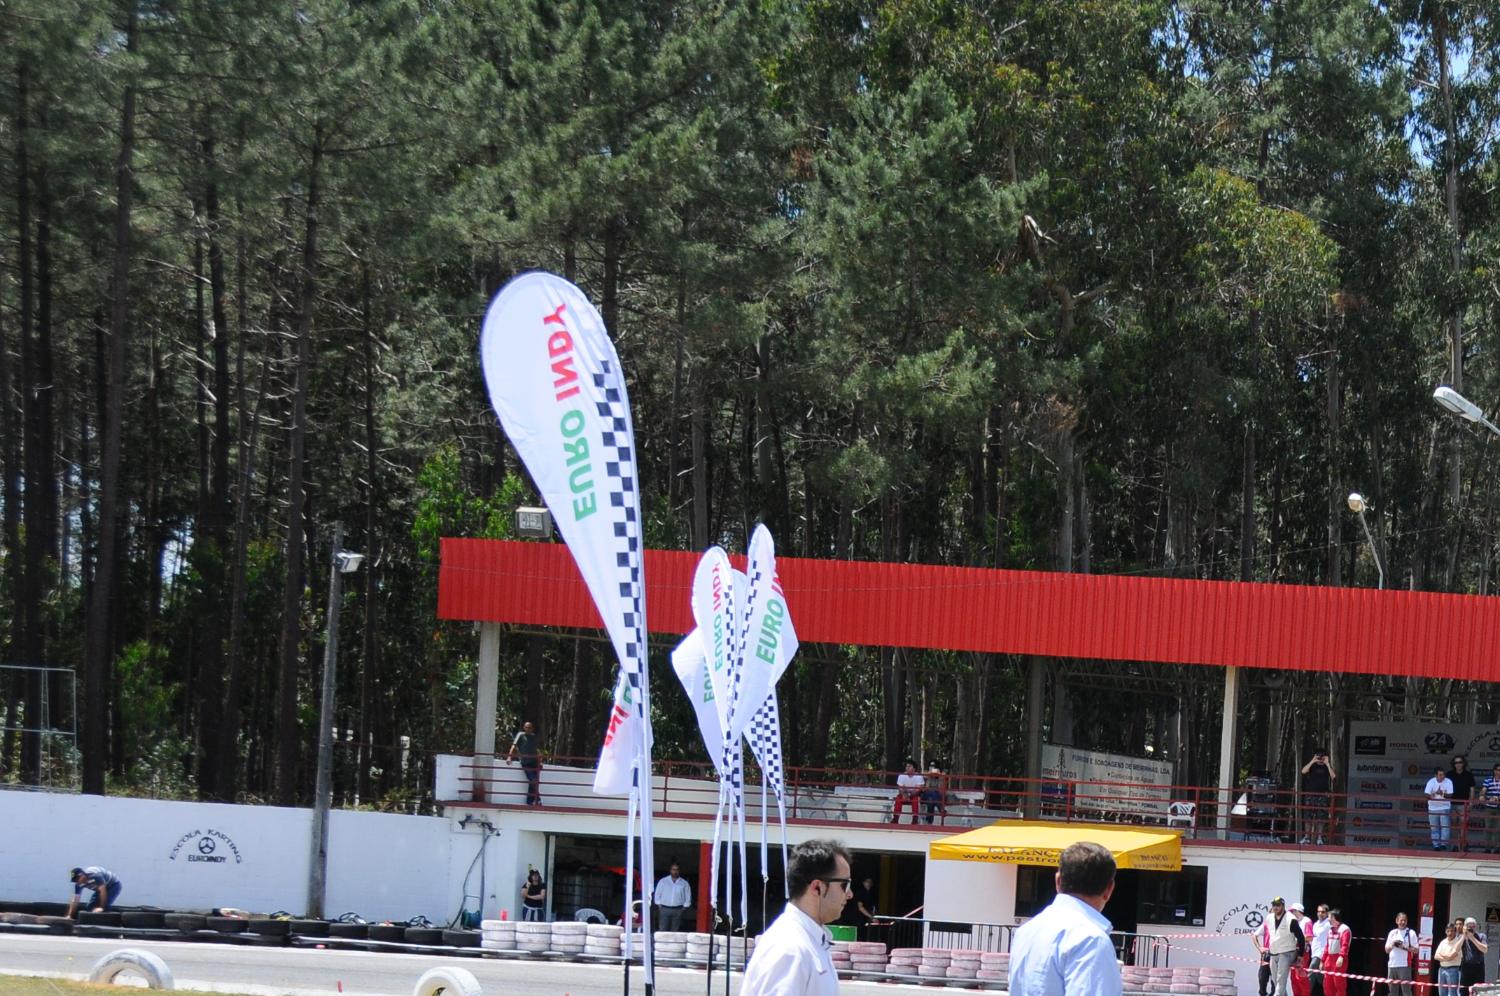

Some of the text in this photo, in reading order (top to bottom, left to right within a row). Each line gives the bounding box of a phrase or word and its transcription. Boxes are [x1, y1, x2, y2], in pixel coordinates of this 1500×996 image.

[755, 598, 785, 665] EURO
[169, 829, 242, 864] ESCOLA KARTING
[187, 854, 227, 863] EUROINDY
[1216, 903, 1249, 933] ESCOLA
